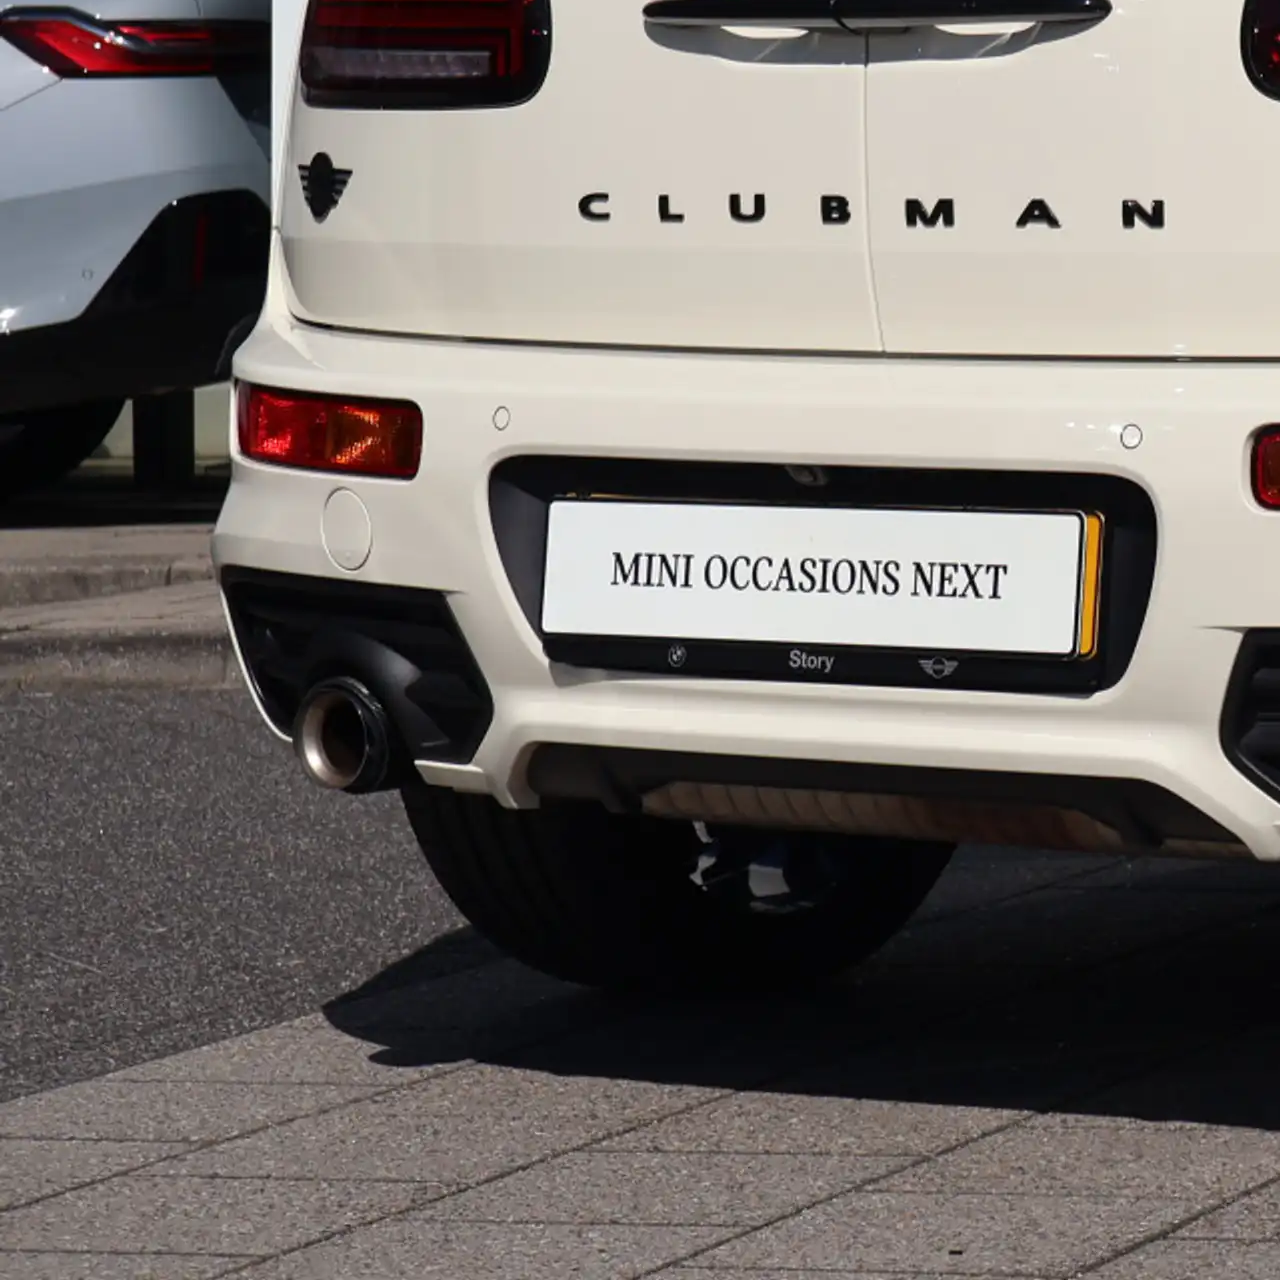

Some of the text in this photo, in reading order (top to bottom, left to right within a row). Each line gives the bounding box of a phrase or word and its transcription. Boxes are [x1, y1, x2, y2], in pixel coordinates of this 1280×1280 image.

[578, 192, 1166, 230] CLUBMAN
[610, 551, 1008, 600] MINI OCCASIONS NEXT
[788, 649, 835, 673] Story
